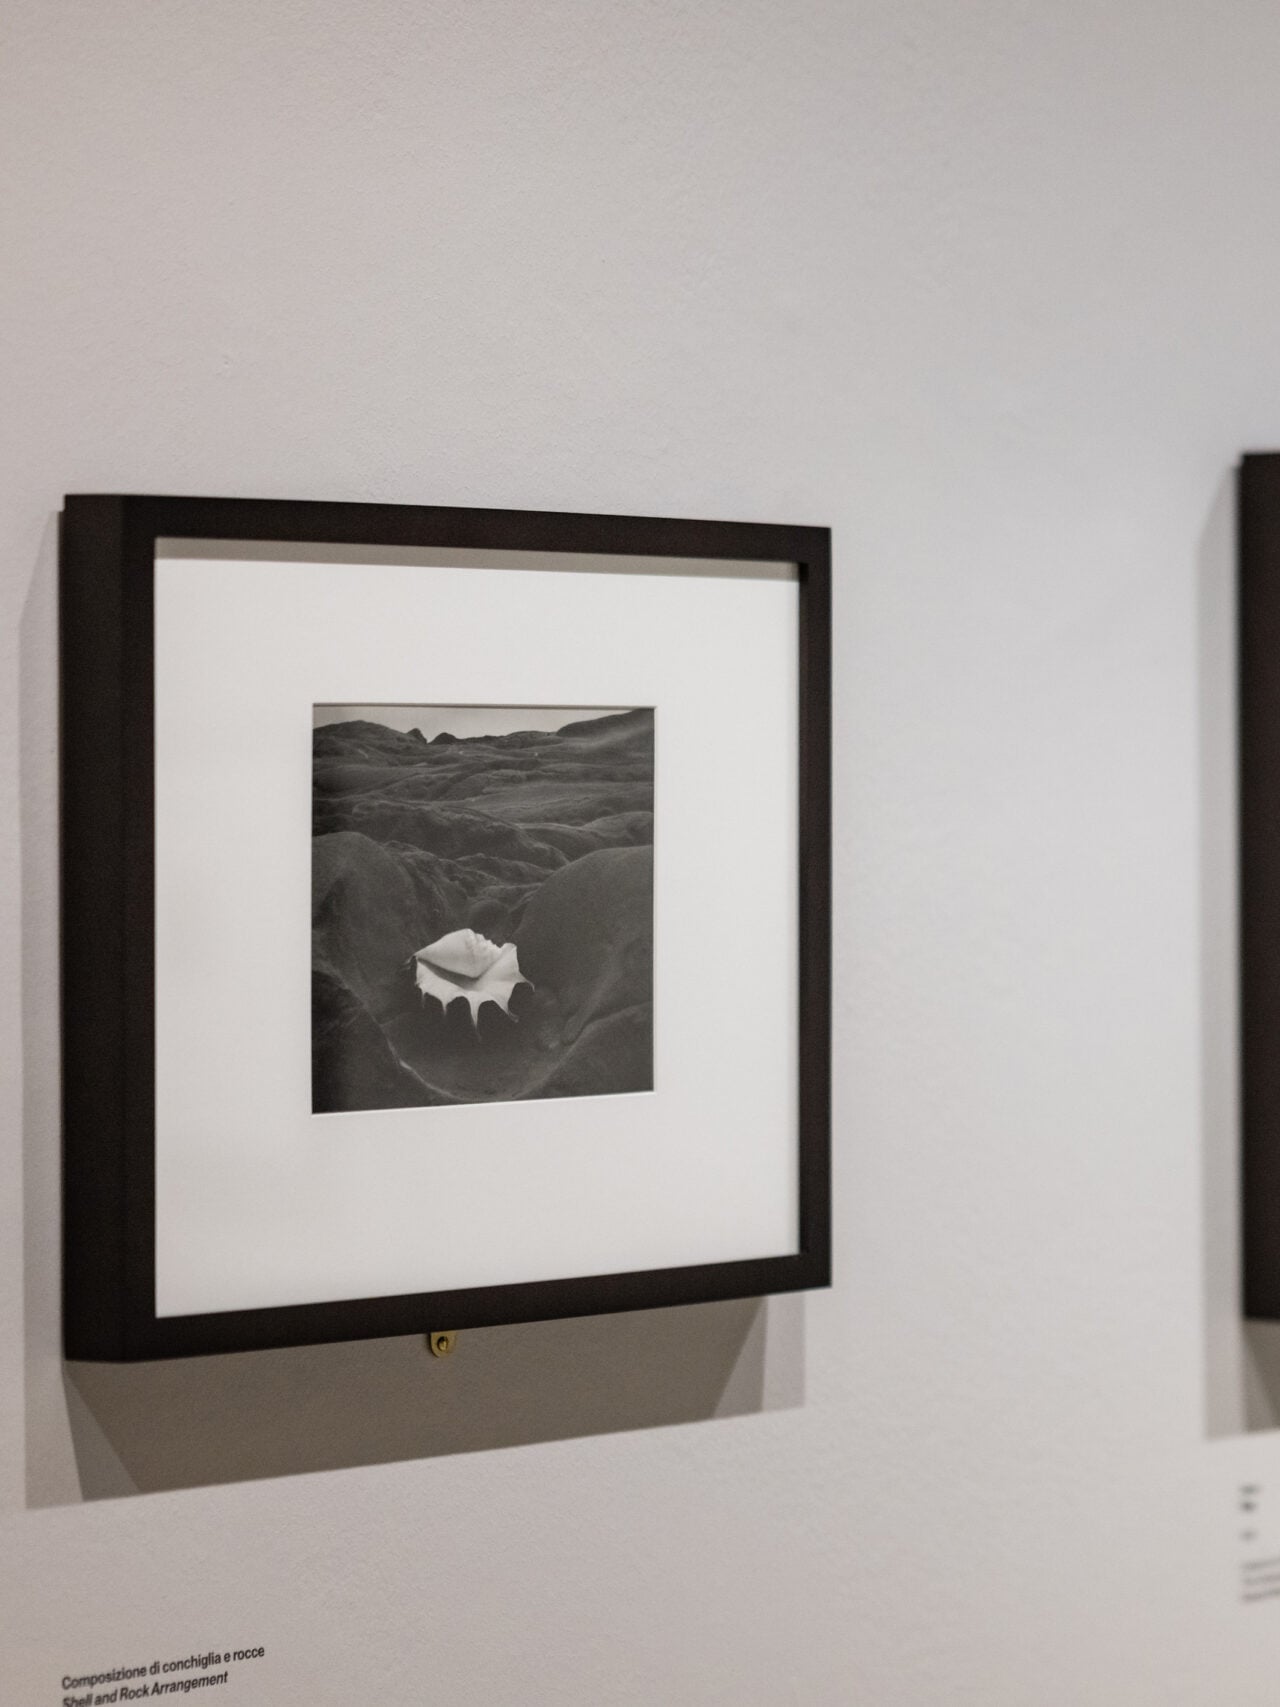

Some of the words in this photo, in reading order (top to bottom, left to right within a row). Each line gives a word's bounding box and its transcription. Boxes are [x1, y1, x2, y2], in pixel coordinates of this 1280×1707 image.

[61, 1665, 147, 1690] Composizione
[149, 1661, 161, 1676] di
[162, 1652, 222, 1673] conchiglia
[223, 1653, 231, 1663] e
[233, 1646, 265, 1661] rocce
[62, 1691, 93, 1707] Shell
[94, 1689, 118, 1706] and
[119, 1684, 150, 1701] Rock
[150, 1671, 228, 1696] Arrangement
